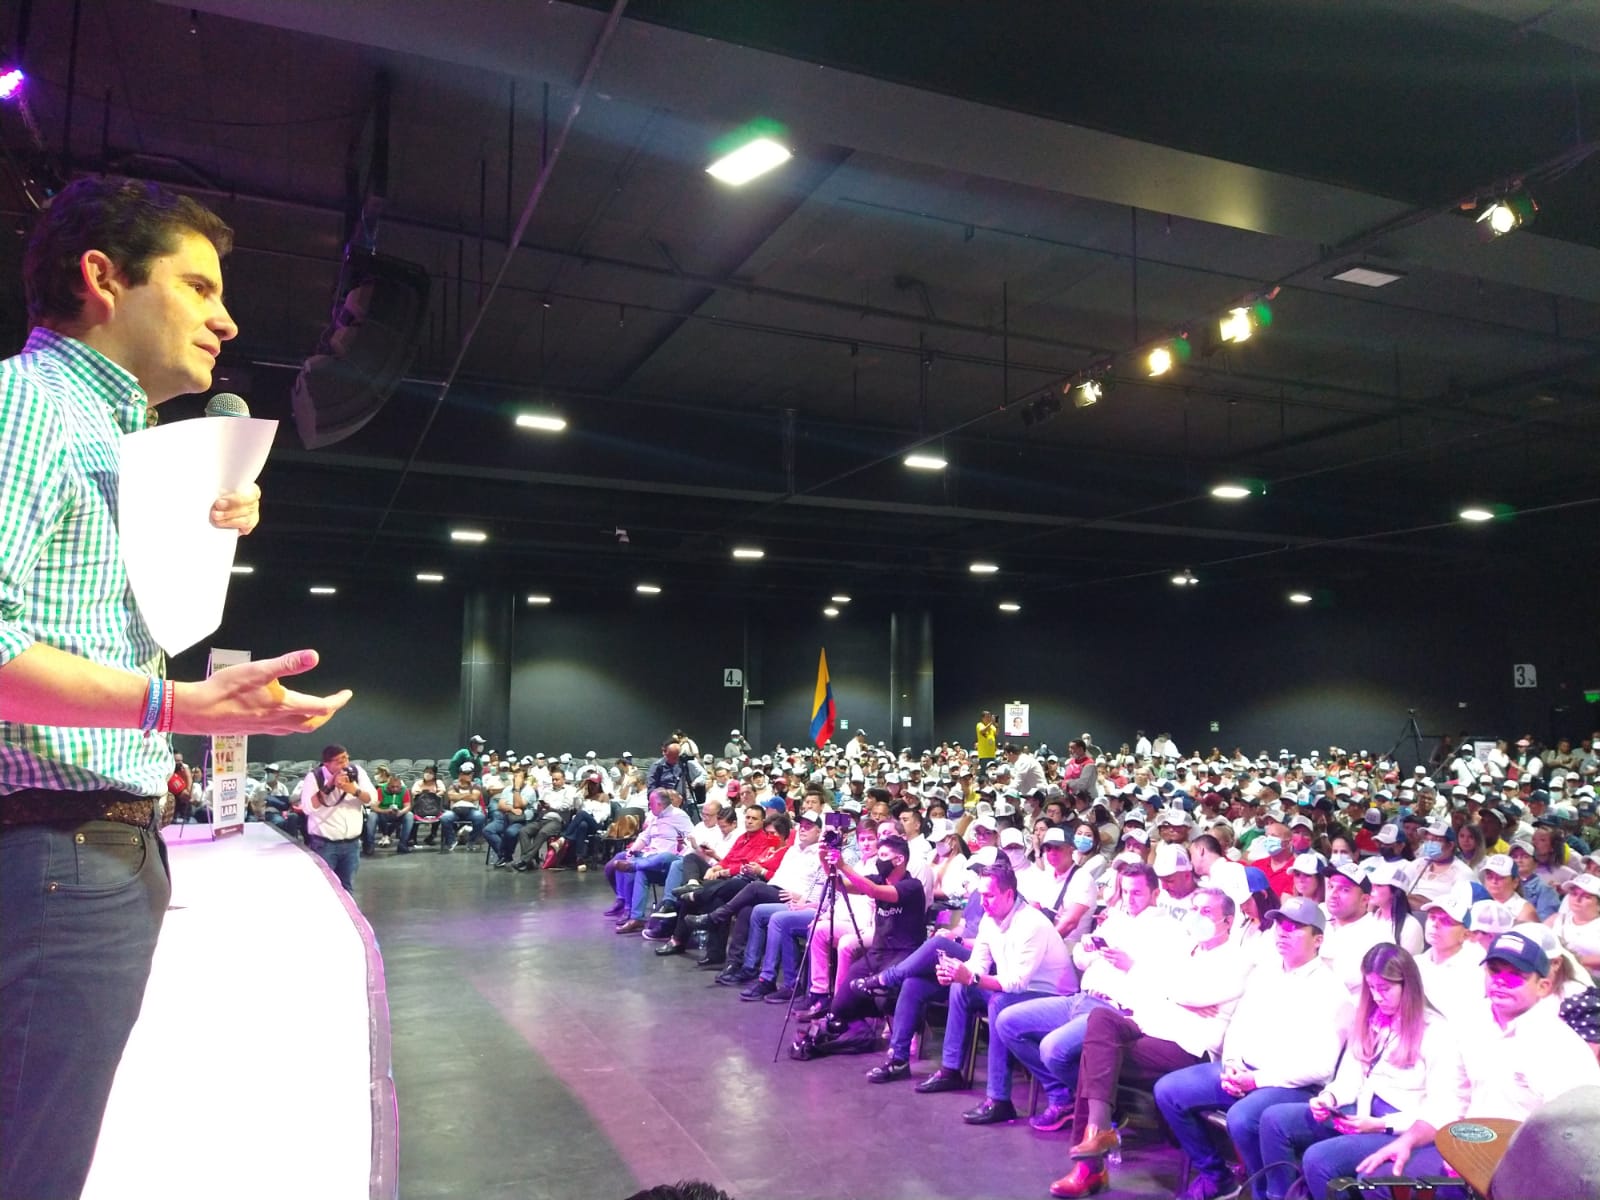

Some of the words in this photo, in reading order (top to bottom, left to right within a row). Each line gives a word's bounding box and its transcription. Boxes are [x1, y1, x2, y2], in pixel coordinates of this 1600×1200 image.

[726, 670, 733, 685] 4
[1516, 666, 1525, 685] 3
[222, 779, 237, 792] FICO
[221, 804, 237, 817] LARA
